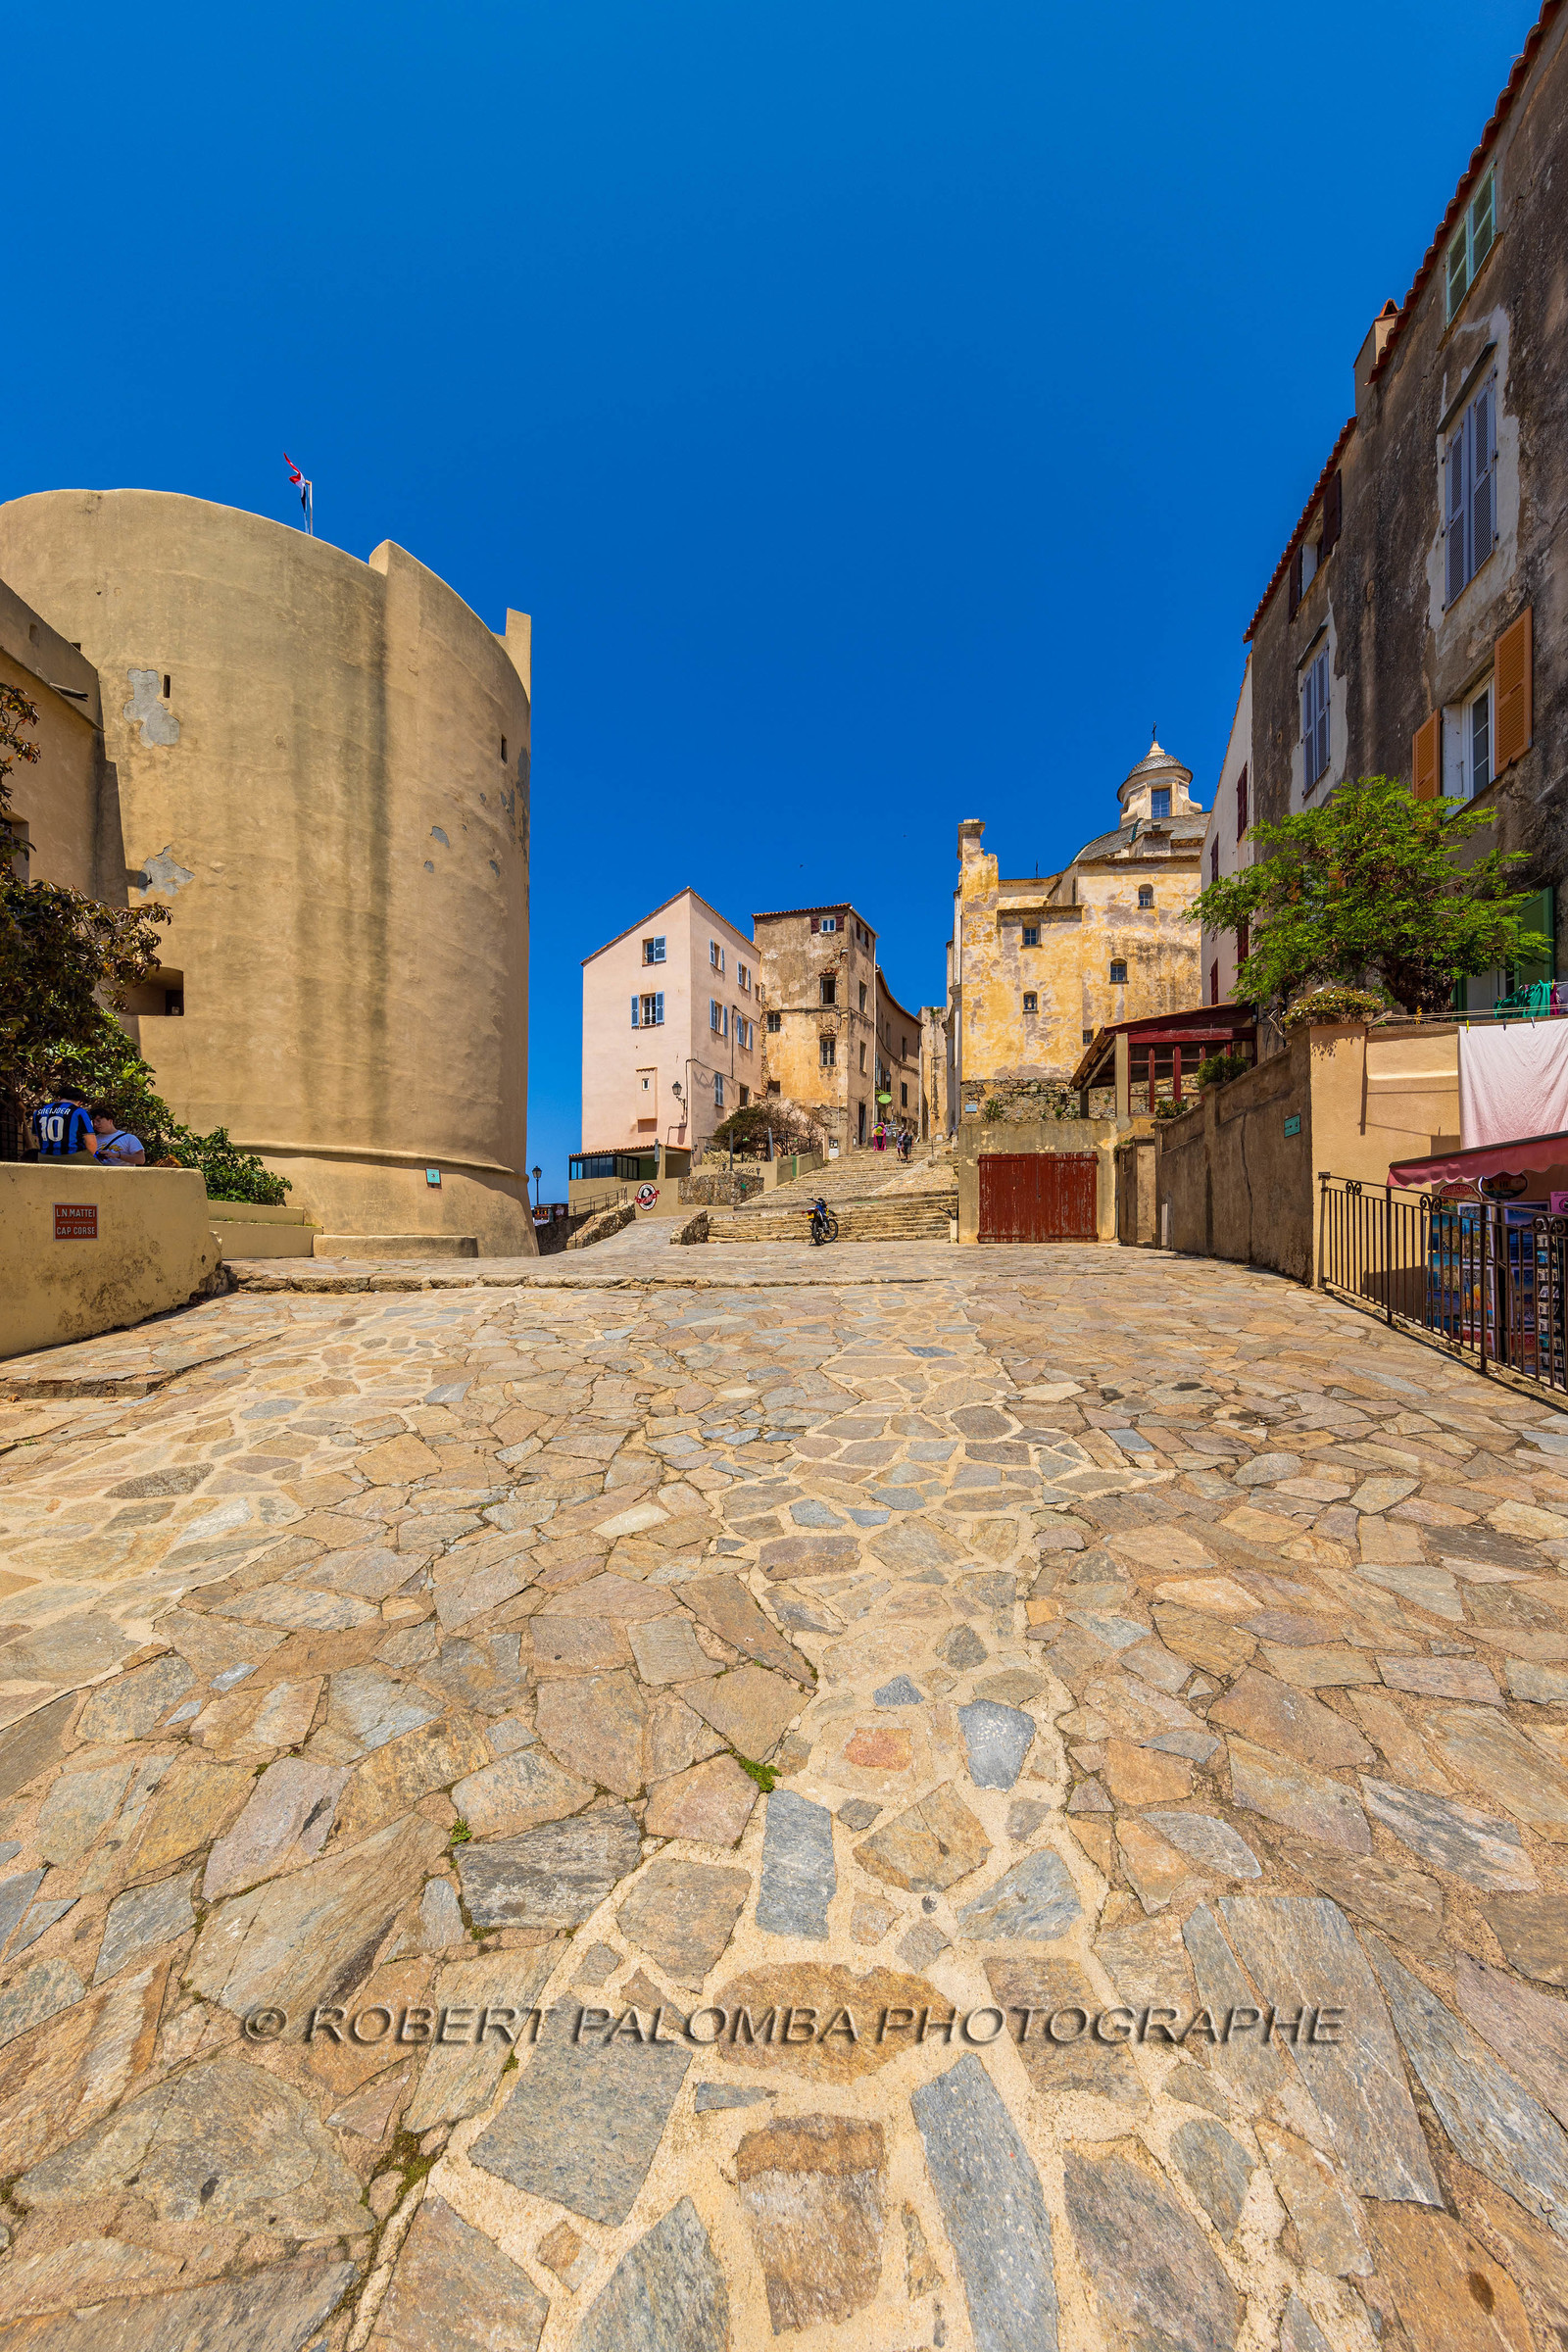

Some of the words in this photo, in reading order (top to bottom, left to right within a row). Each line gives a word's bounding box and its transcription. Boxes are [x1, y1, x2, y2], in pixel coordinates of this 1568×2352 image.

[38, 1115, 65, 1142] 10
[56, 1226, 72, 1235] CAP
[74, 1226, 95, 1235] CORSE
